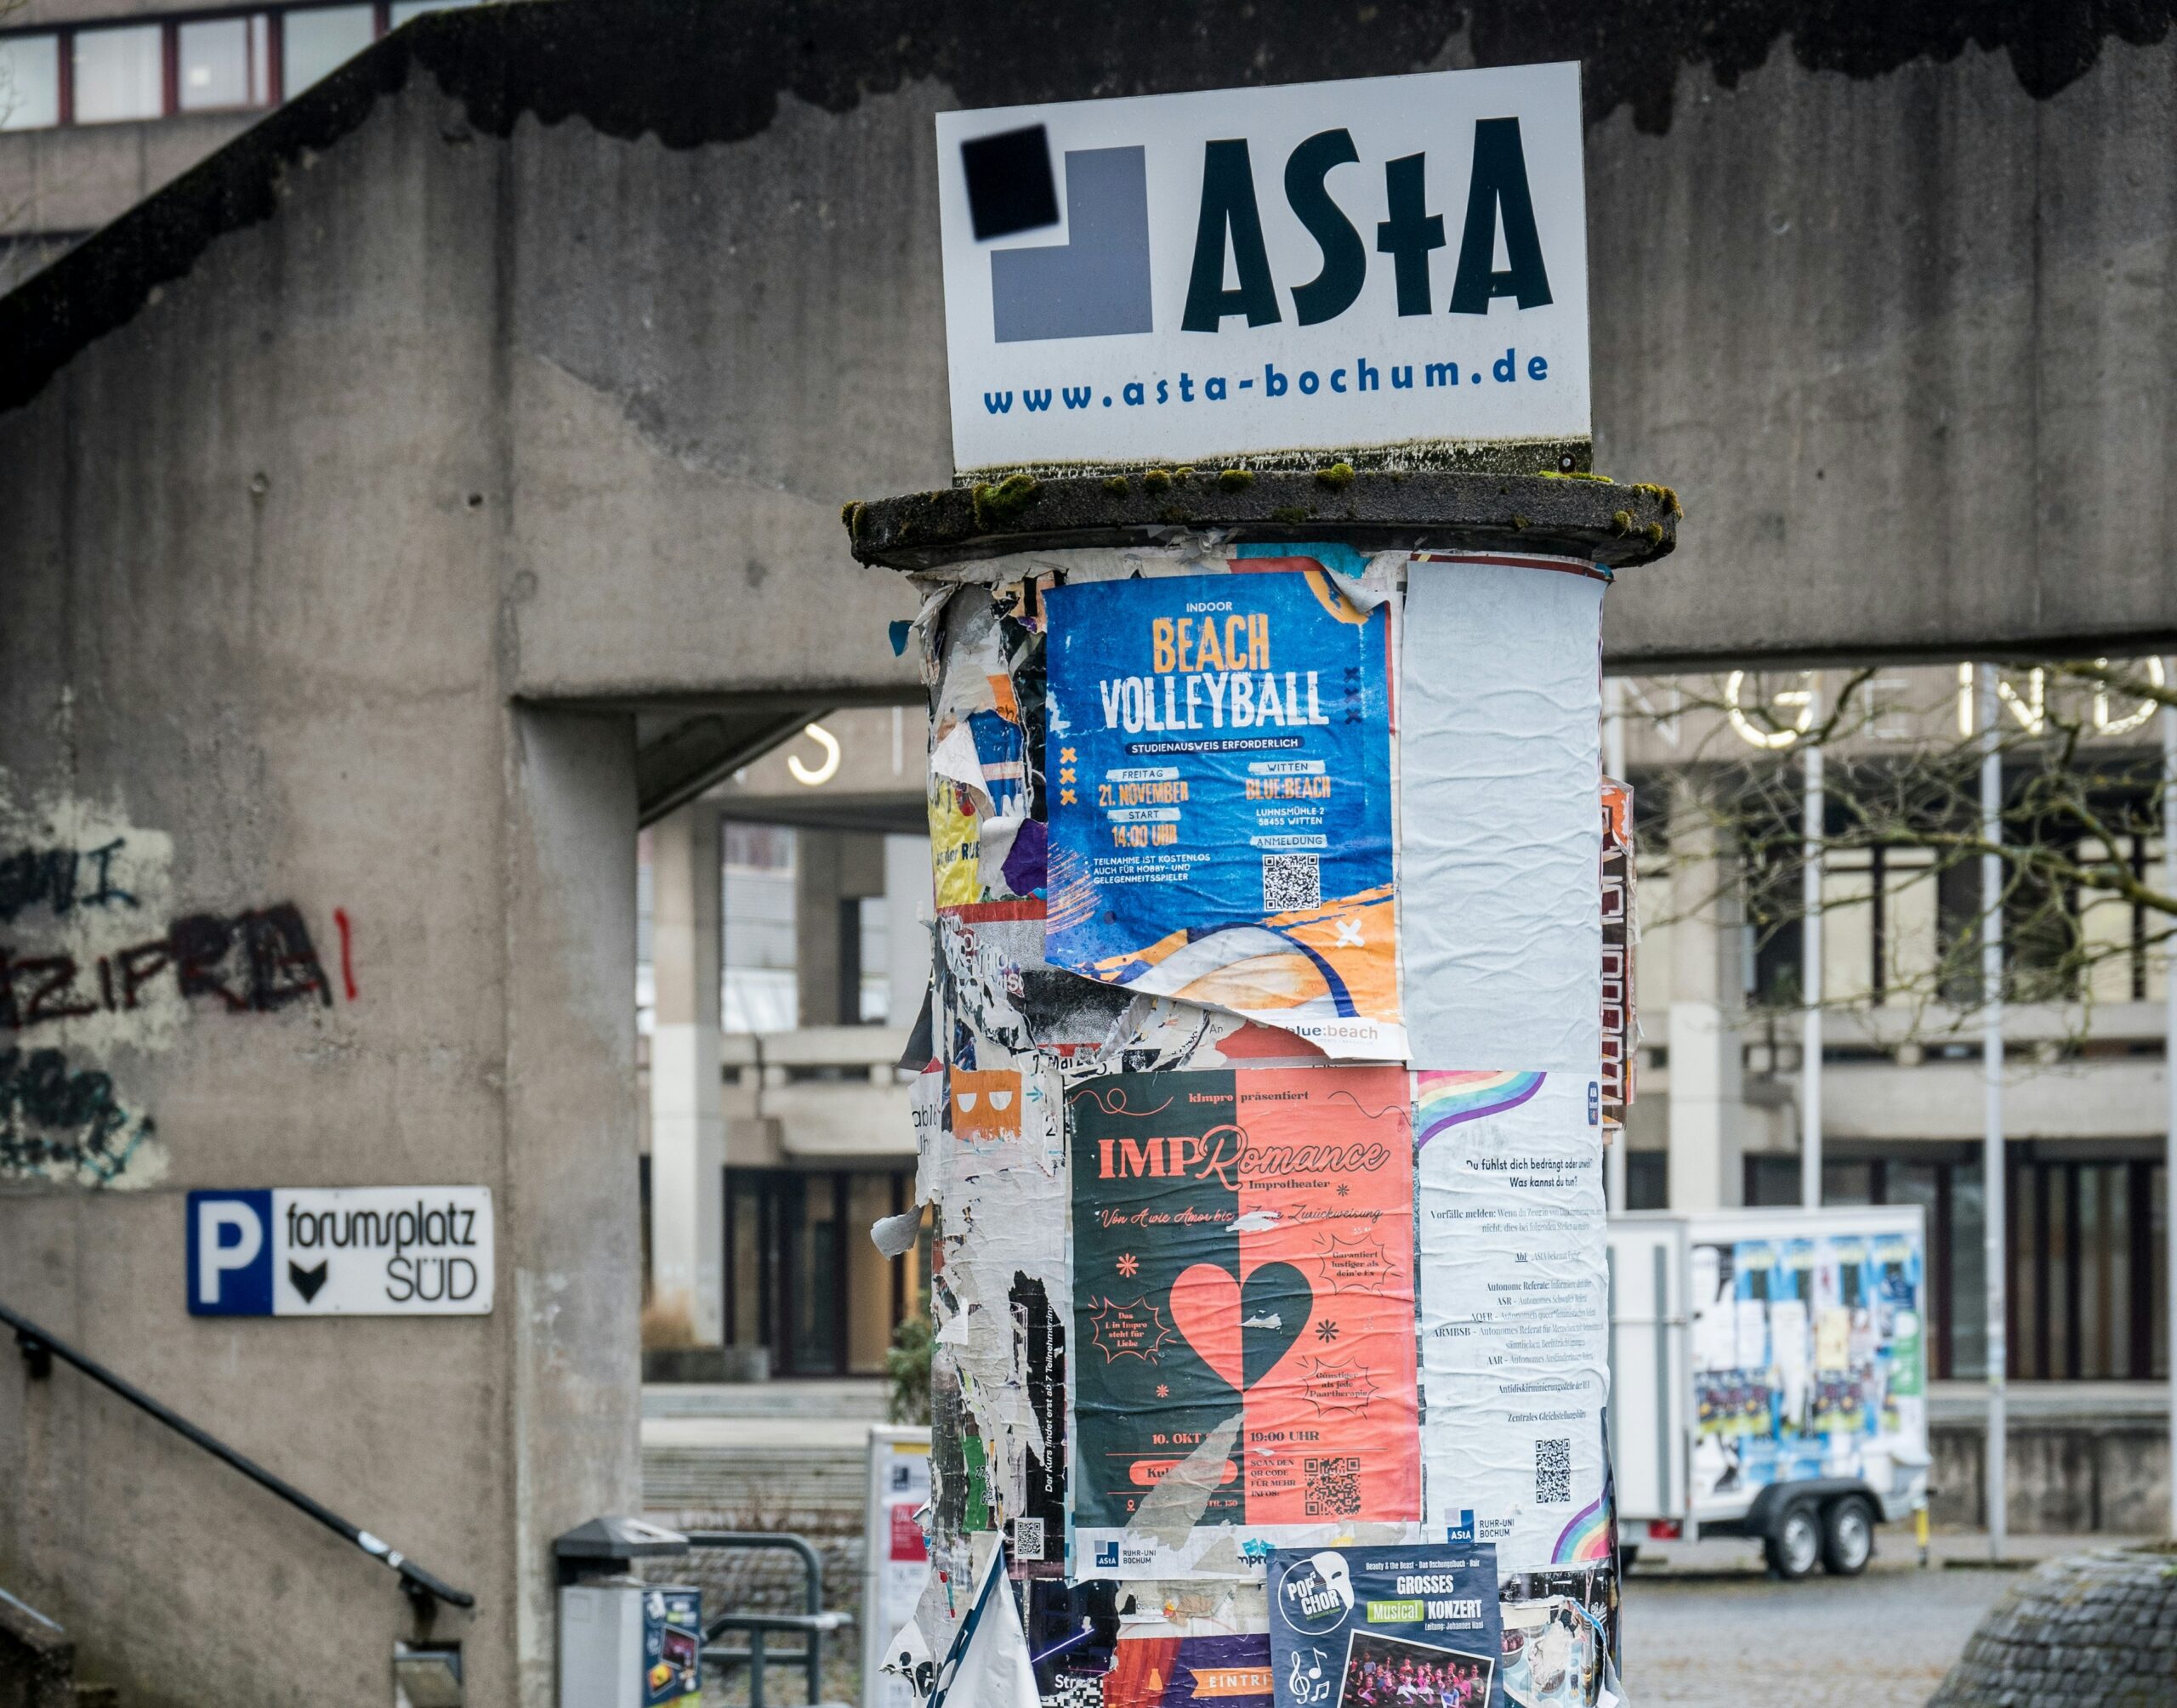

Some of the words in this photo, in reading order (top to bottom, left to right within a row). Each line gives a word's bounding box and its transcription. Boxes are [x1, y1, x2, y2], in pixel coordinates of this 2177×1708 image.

[1181, 116, 1555, 332] AStA
[984, 349, 1549, 415] www.asta-bochum.de
[1185, 601, 1233, 612] INDOOR
[1152, 613, 1270, 673] BEACH
[1100, 670, 1330, 734] VOLLEYBALL
[1131, 741, 1219, 754] STUDIENAUSWEIS
[1222, 738, 1299, 750] ERFORDERLICH
[1267, 762, 1309, 773] WITTEN
[1122, 769, 1164, 780] FREITAG
[1099, 784, 1117, 807] 21.
[1119, 781, 1190, 806] NOVEMBER
[1245, 775, 1331, 801] BLUE:BEACH
[1128, 809, 1160, 820] START
[1256, 807, 1317, 818] LUHNSMÜHLE
[1319, 807, 1325, 816] 2
[1287, 816, 1323, 826] WITTEN
[1111, 825, 1149, 848] 14:00
[1151, 823, 1179, 848] UHR
[1257, 836, 1324, 847] ANMELDUNG
[1094, 856, 1141, 865] TEILNAHME
[1142, 855, 1157, 864] IST
[1158, 854, 1211, 864] KOSTENLOS
[1094, 865, 1117, 876] AUCH
[1118, 865, 1135, 874] FÜR
[1136, 864, 1169, 874] HOBBY-
[1170, 863, 1191, 872] UND
[1094, 874, 1189, 885] GELEGENHEITSSPIELER
[1241, 1090, 1309, 1104] präsentiert
[1481, 1158, 1508, 1171] fühlst
[1510, 1157, 1529, 1170] dich
[1531, 1156, 1564, 1172] bedrängt
[1565, 1158, 1578, 1170] oder
[1249, 1178, 1331, 1190] Improtheater
[1509, 1177, 1528, 1188] Was
[1530, 1177, 1555, 1188] kannst
[1556, 1176, 1565, 1187] du
[1100, 1207, 1128, 1228] Von
[1131, 1206, 1149, 1228] A
[1150, 1212, 1169, 1223] wie
[1174, 1206, 1211, 1227] Amor
[1213, 1210, 1235, 1223] bis
[1288, 1204, 1383, 1224] Zurückweisung
[1430, 1209, 1464, 1219] Vorfälle
[1465, 1207, 1497, 1218] melden:
[287, 1201, 476, 1257] forumsplatz
[199, 1200, 263, 1303] P
[1332, 1251, 1378, 1259] Garantiert
[1331, 1260, 1363, 1269] lustiger
[1366, 1259, 1379, 1268] als
[386, 1257, 478, 1302] SÜD
[1485, 1282, 1522, 1292] Autonome
[1523, 1280, 1550, 1291] Referate:
[1497, 1297, 1512, 1306] ASR
[1112, 1321, 1122, 1330] in
[1123, 1321, 1148, 1331] Impro
[1479, 1325, 1519, 1336] Autonomes
[1109, 1331, 1128, 1339] steht
[1130, 1330, 1145, 1338] für
[1117, 1339, 1139, 1348] Liebe
[1316, 1370, 1358, 1380] Günstiger
[1336, 1380, 1354, 1389] jede
[1044, 1385, 1053, 1397] ab
[1310, 1389, 1367, 1399] Paartherapie
[1044, 1398, 1053, 1417] erst
[1508, 1412, 1538, 1422] Zentrales
[1151, 1434, 1169, 1444] 10.
[1250, 1432, 1286, 1444] 19:00
[1289, 1430, 1320, 1443] UHR
[1044, 1450, 1053, 1473] Kurs
[1044, 1476, 1054, 1493] Der
[1480, 1518, 1515, 1529] RUHR-UNI
[1451, 1529, 1472, 1540] AStA
[1480, 1529, 1510, 1538] BOCHUM
[1123, 1549, 1157, 1558] RUHR-UNI
[1098, 1556, 1117, 1565] AStA
[1366, 1561, 1384, 1571] Beauty
[1390, 1561, 1398, 1569] the
[1400, 1560, 1414, 1569] Beast
[1287, 1578, 1314, 1601] POP
[1396, 1575, 1454, 1595] GROSSES
[1300, 1589, 1340, 1615] CHOR
[1373, 1601, 1418, 1620] Musical
[1428, 1599, 1482, 1620] KONZERT
[1424, 1621, 1446, 1631] Leitung:
[1446, 1620, 1471, 1630] Johannes
